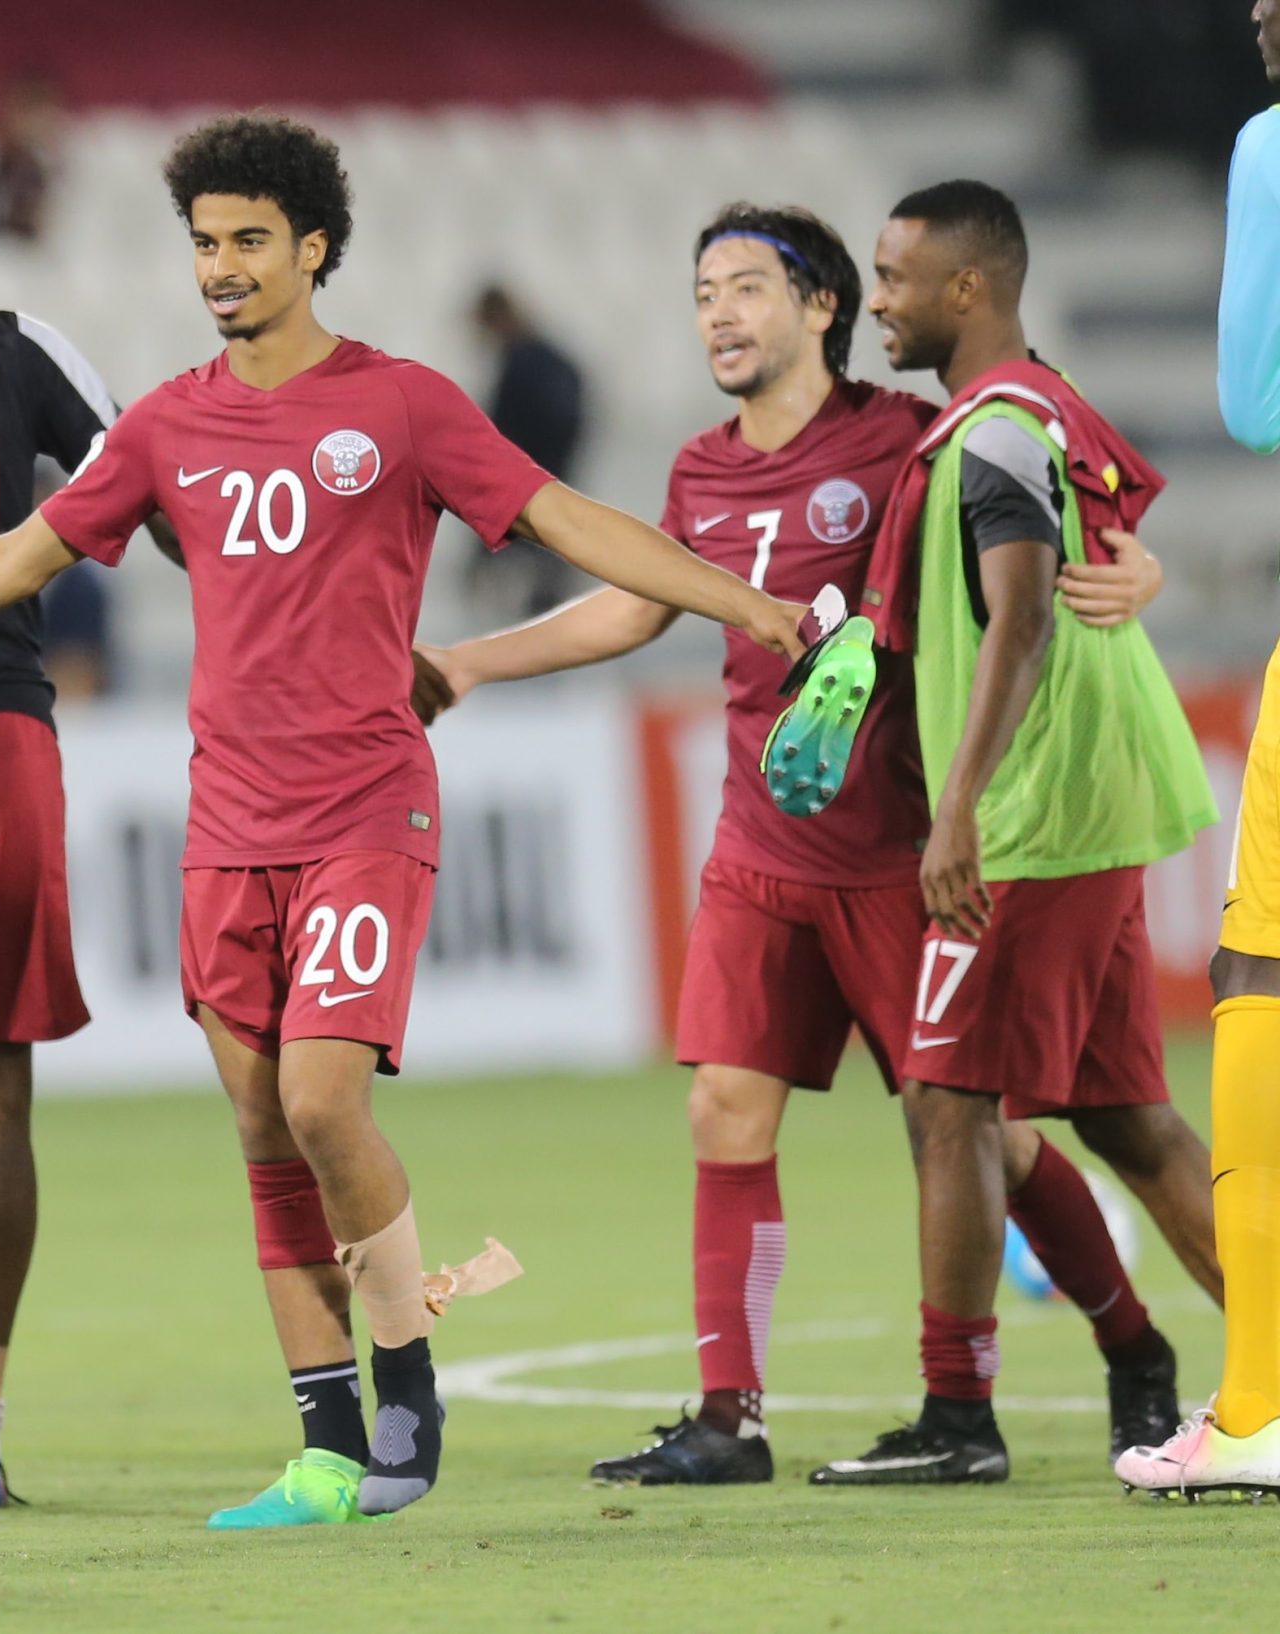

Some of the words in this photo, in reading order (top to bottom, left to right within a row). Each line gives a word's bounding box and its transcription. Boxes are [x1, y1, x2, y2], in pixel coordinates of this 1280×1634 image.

[220, 468, 308, 557] 20
[334, 476, 359, 489] QFA
[746, 508, 784, 591] 7
[298, 902, 390, 988] 20
[914, 938, 980, 1026] 17
